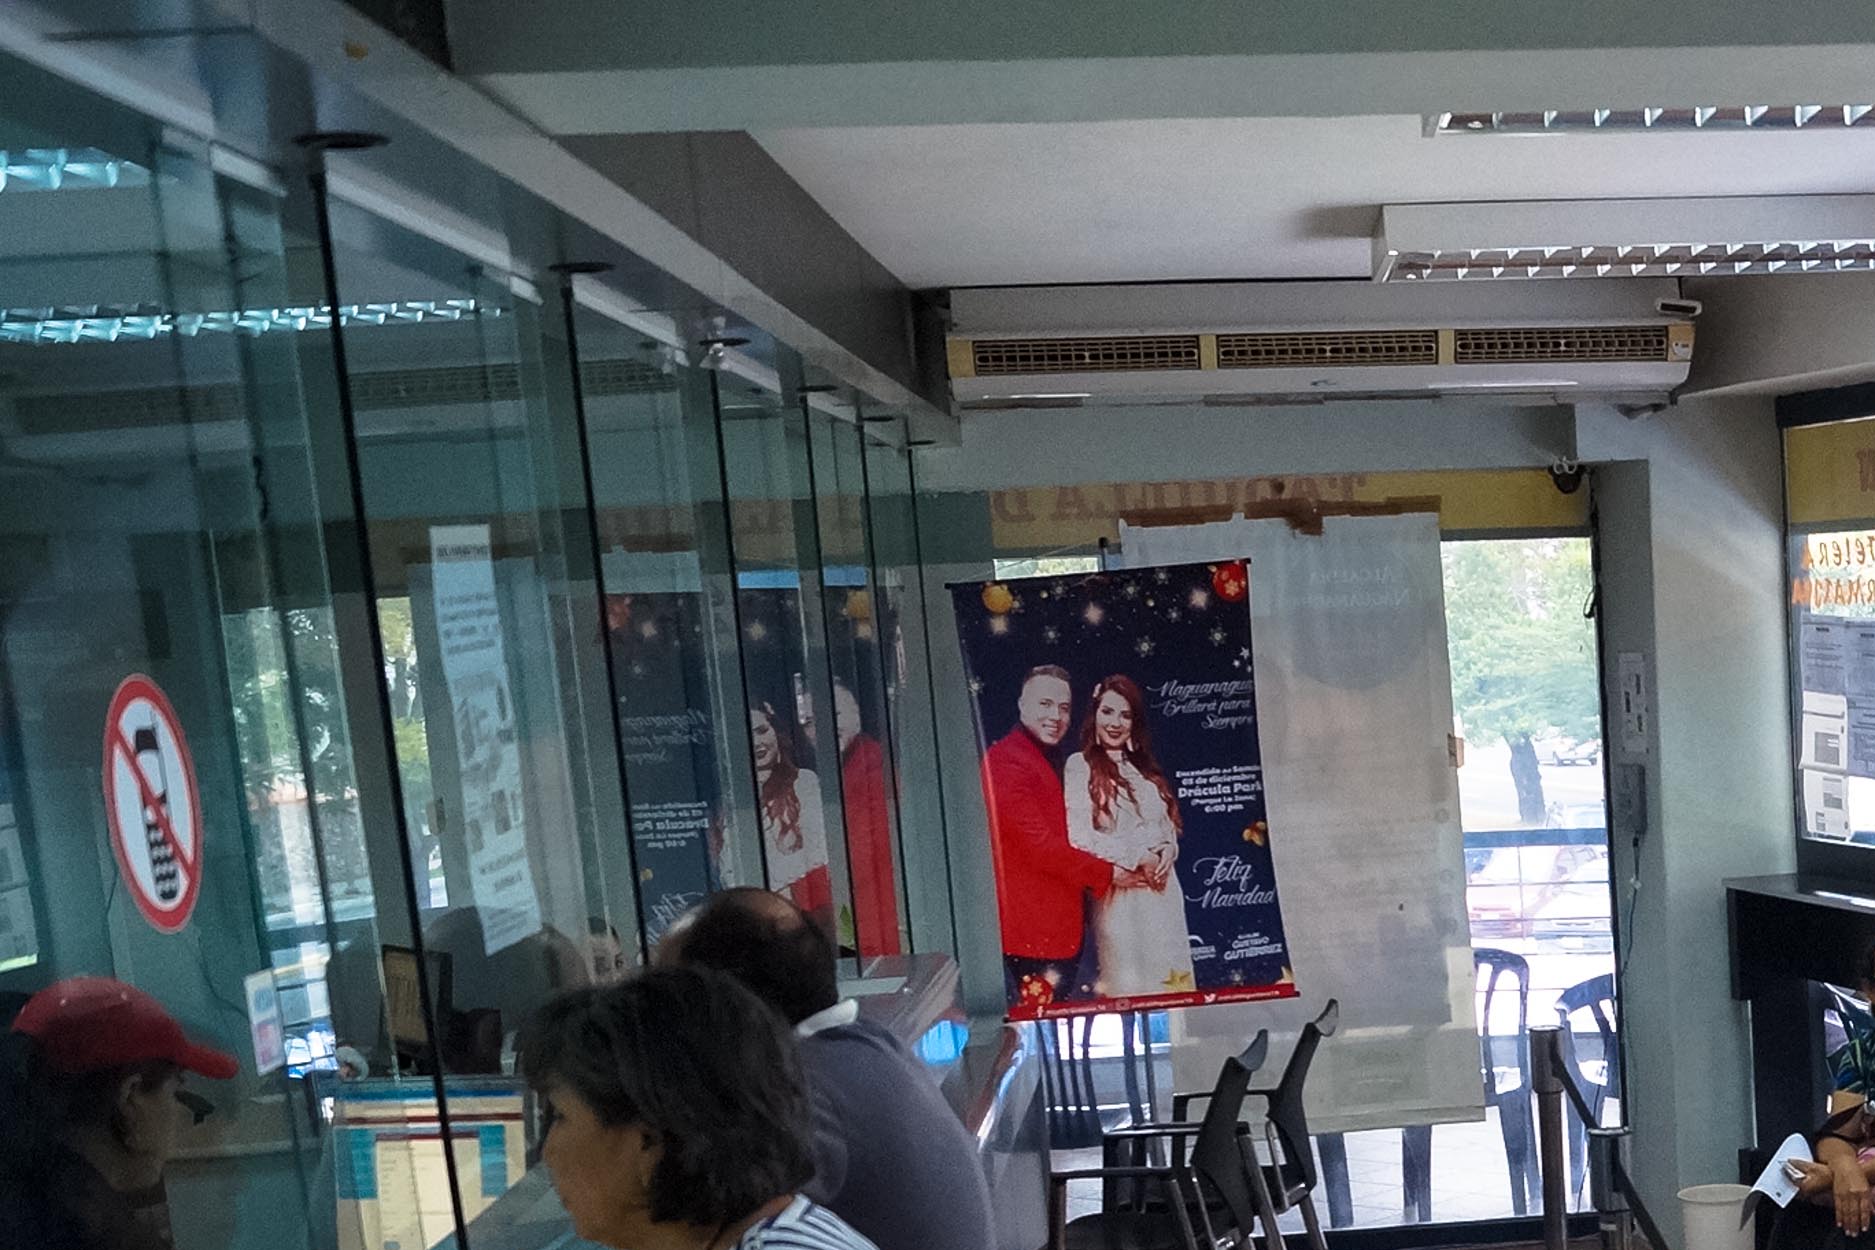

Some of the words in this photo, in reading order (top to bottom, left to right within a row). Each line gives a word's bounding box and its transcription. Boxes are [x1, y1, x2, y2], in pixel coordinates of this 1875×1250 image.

[1178, 784, 1231, 799] Drácula
[1193, 855, 1253, 892] Feliz
[1185, 884, 1276, 909] Navidad
